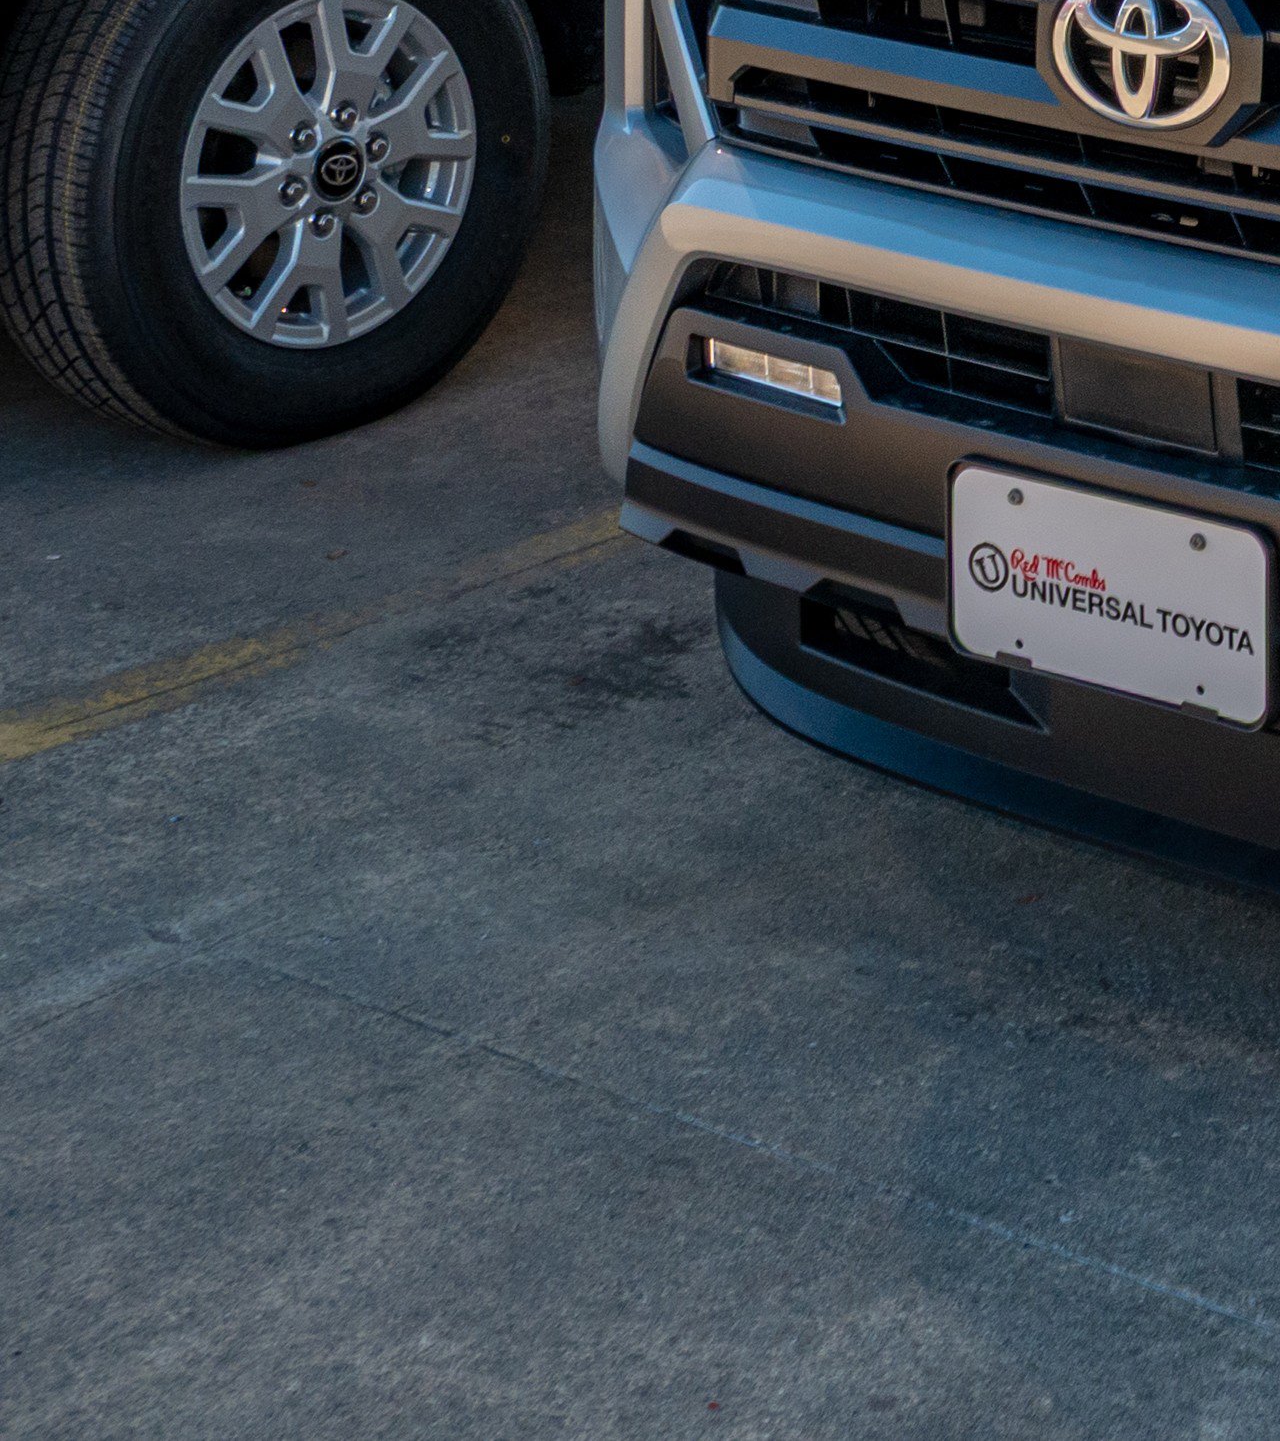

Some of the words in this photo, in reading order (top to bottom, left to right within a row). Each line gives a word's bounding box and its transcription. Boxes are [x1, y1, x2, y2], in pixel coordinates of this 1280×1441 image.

[1010, 548, 1039, 582] Red
[1041, 553, 1106, 592] McCombs
[1011, 574, 1154, 630] UNIVERSAL
[1156, 608, 1255, 656] TOYOTA
